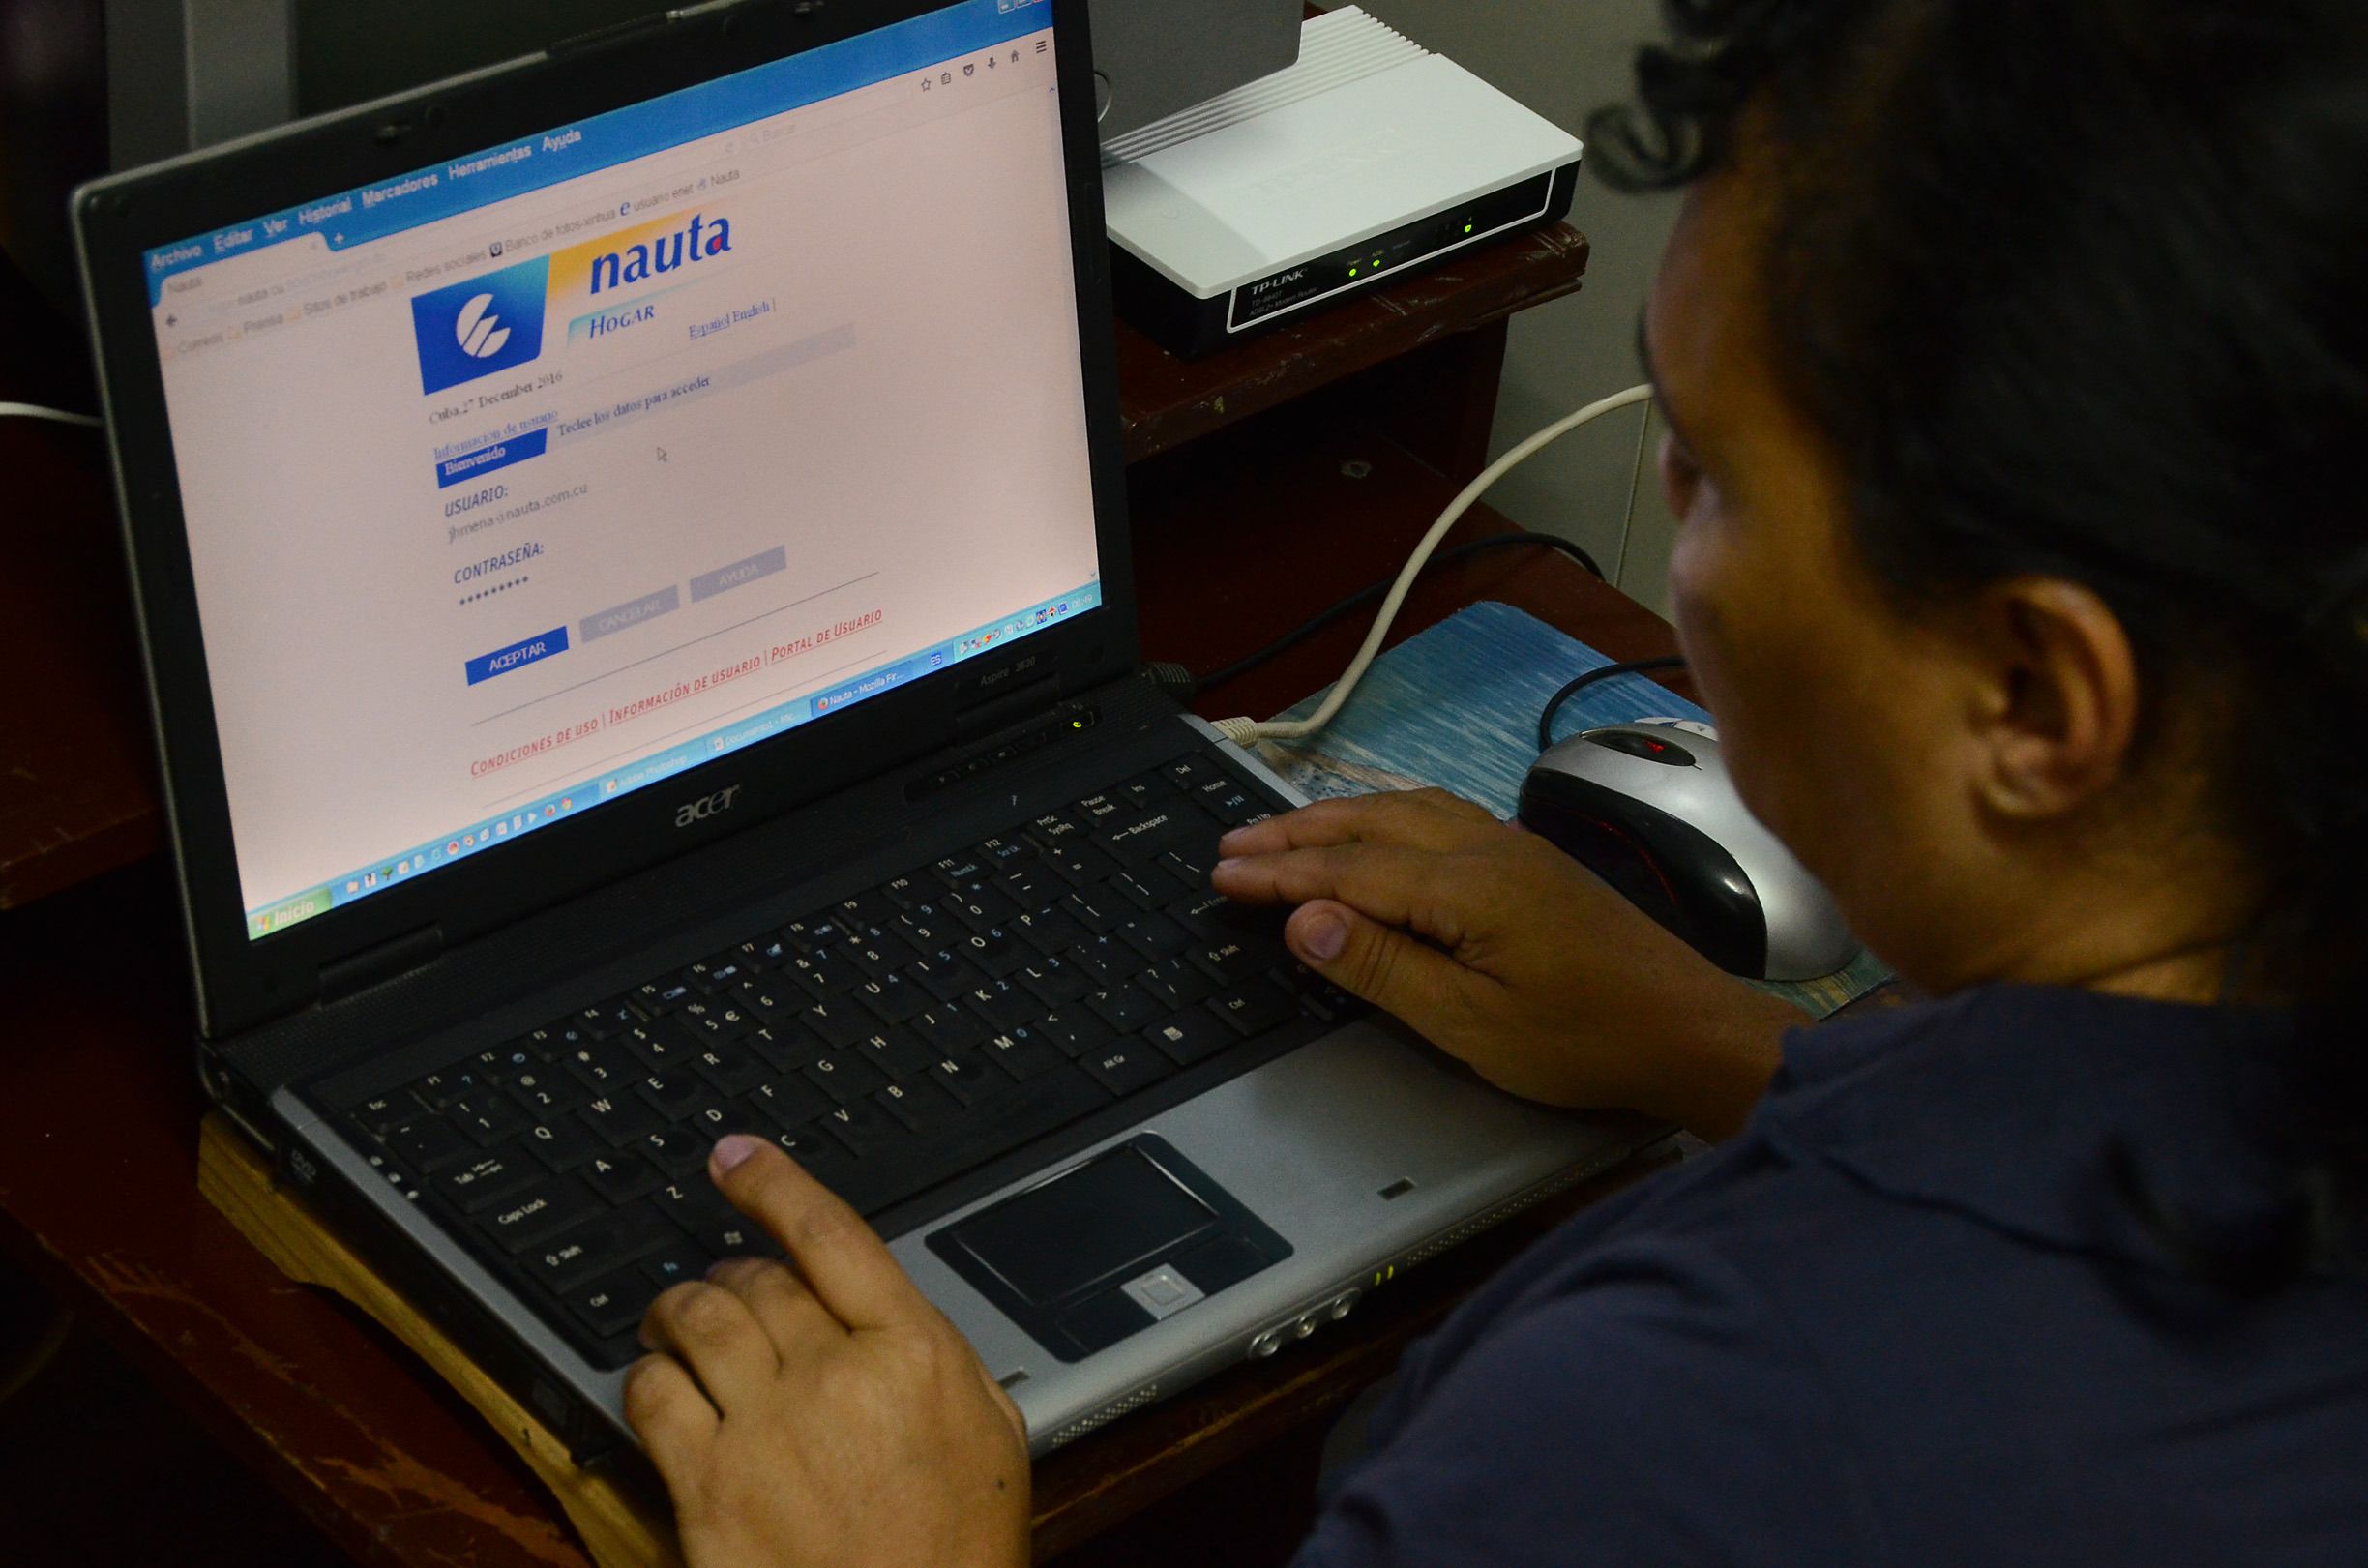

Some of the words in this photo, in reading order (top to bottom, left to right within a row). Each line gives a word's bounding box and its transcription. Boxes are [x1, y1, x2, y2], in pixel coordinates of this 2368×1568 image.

[151, 243, 201, 269] Archivo
[214, 227, 253, 252] Editar
[263, 218, 287, 236] Ver
[299, 196, 351, 225] Historial
[362, 173, 438, 207] Marcadores
[448, 144, 531, 181] Herramientas
[542, 129, 582, 153] Ayuda
[335, 293, 348, 307] de
[405, 263, 441, 282] Redes
[444, 250, 486, 272] sociales
[505, 235, 539, 253] Banco
[541, 227, 555, 241] de
[634, 192, 670, 211] usuario
[710, 168, 740, 186] Nauta
[590, 212, 732, 296] nauta
[1250, 268, 1305, 296] TP-LINK
[589, 305, 655, 339] HOGAR
[689, 313, 731, 340] Español
[732, 301, 771, 325] English
[478, 383, 534, 409] December
[537, 371, 564, 390] 2016
[557, 417, 592, 437] Teclee
[594, 411, 611, 427] los
[613, 400, 643, 419] datos
[644, 391, 669, 411] para
[670, 374, 712, 399] acceder
[503, 422, 518, 437] de
[445, 445, 506, 476] Bienvenido
[444, 484, 509, 518] USUARIO:
[453, 542, 545, 584] CONTRASEÑA:
[718, 562, 759, 587] AYUDA
[598, 598, 661, 632] CANCELAR
[487, 640, 547, 673] ACEPTAR
[930, 654, 943, 667] ES
[830, 688, 853, 707] Nauta
[860, 676, 886, 695] Mozilla
[674, 783, 743, 829] acer
[275, 900, 315, 927] Inicio
[864, 982, 881, 994] U
[974, 989, 992, 1002] K
[812, 1004, 828, 1017] Y
[869, 1035, 887, 1050] H
[993, 1034, 1015, 1050] M
[702, 1052, 721, 1066] R
[817, 1059, 835, 1072] G
[940, 1059, 960, 1074] N
[647, 1077, 665, 1090] E
[760, 1084, 774, 1098] F
[886, 1085, 903, 1099] B
[590, 1098, 612, 1113] W
[705, 1109, 723, 1122] D
[833, 1109, 850, 1122] V
[649, 1134, 665, 1147] S
[780, 1134, 797, 1147] C
[595, 1159, 612, 1173] A
[666, 1185, 684, 1200] Z
